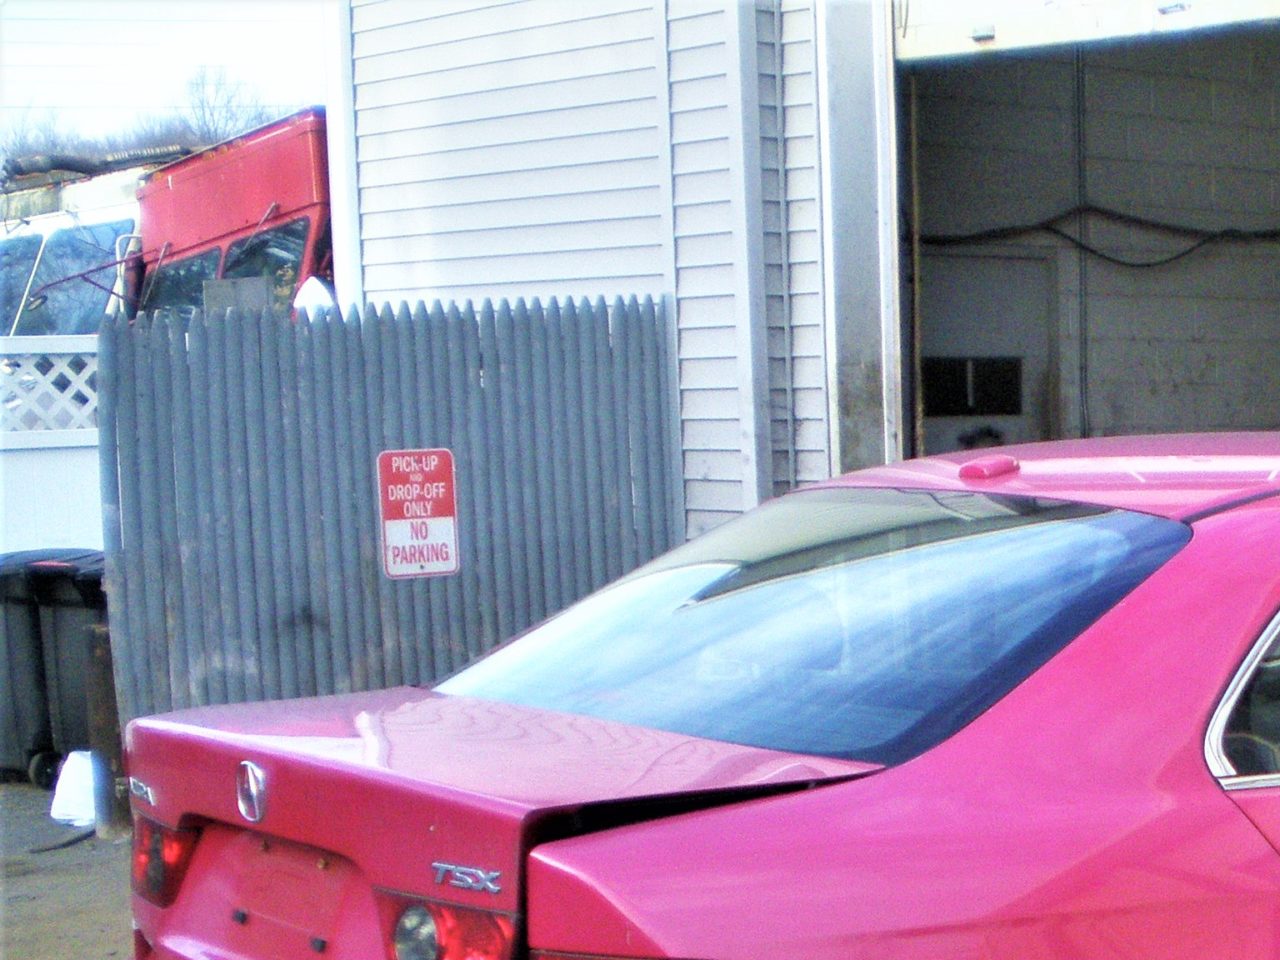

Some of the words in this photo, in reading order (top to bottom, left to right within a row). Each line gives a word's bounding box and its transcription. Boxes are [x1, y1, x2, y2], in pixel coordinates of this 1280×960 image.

[391, 455, 438, 472] PICK-UP
[388, 482, 446, 500] DROP-OFF
[403, 501, 433, 517] ONLY
[410, 521, 428, 540] NO
[391, 542, 450, 564] PARKING
[432, 861, 501, 894] TSX
